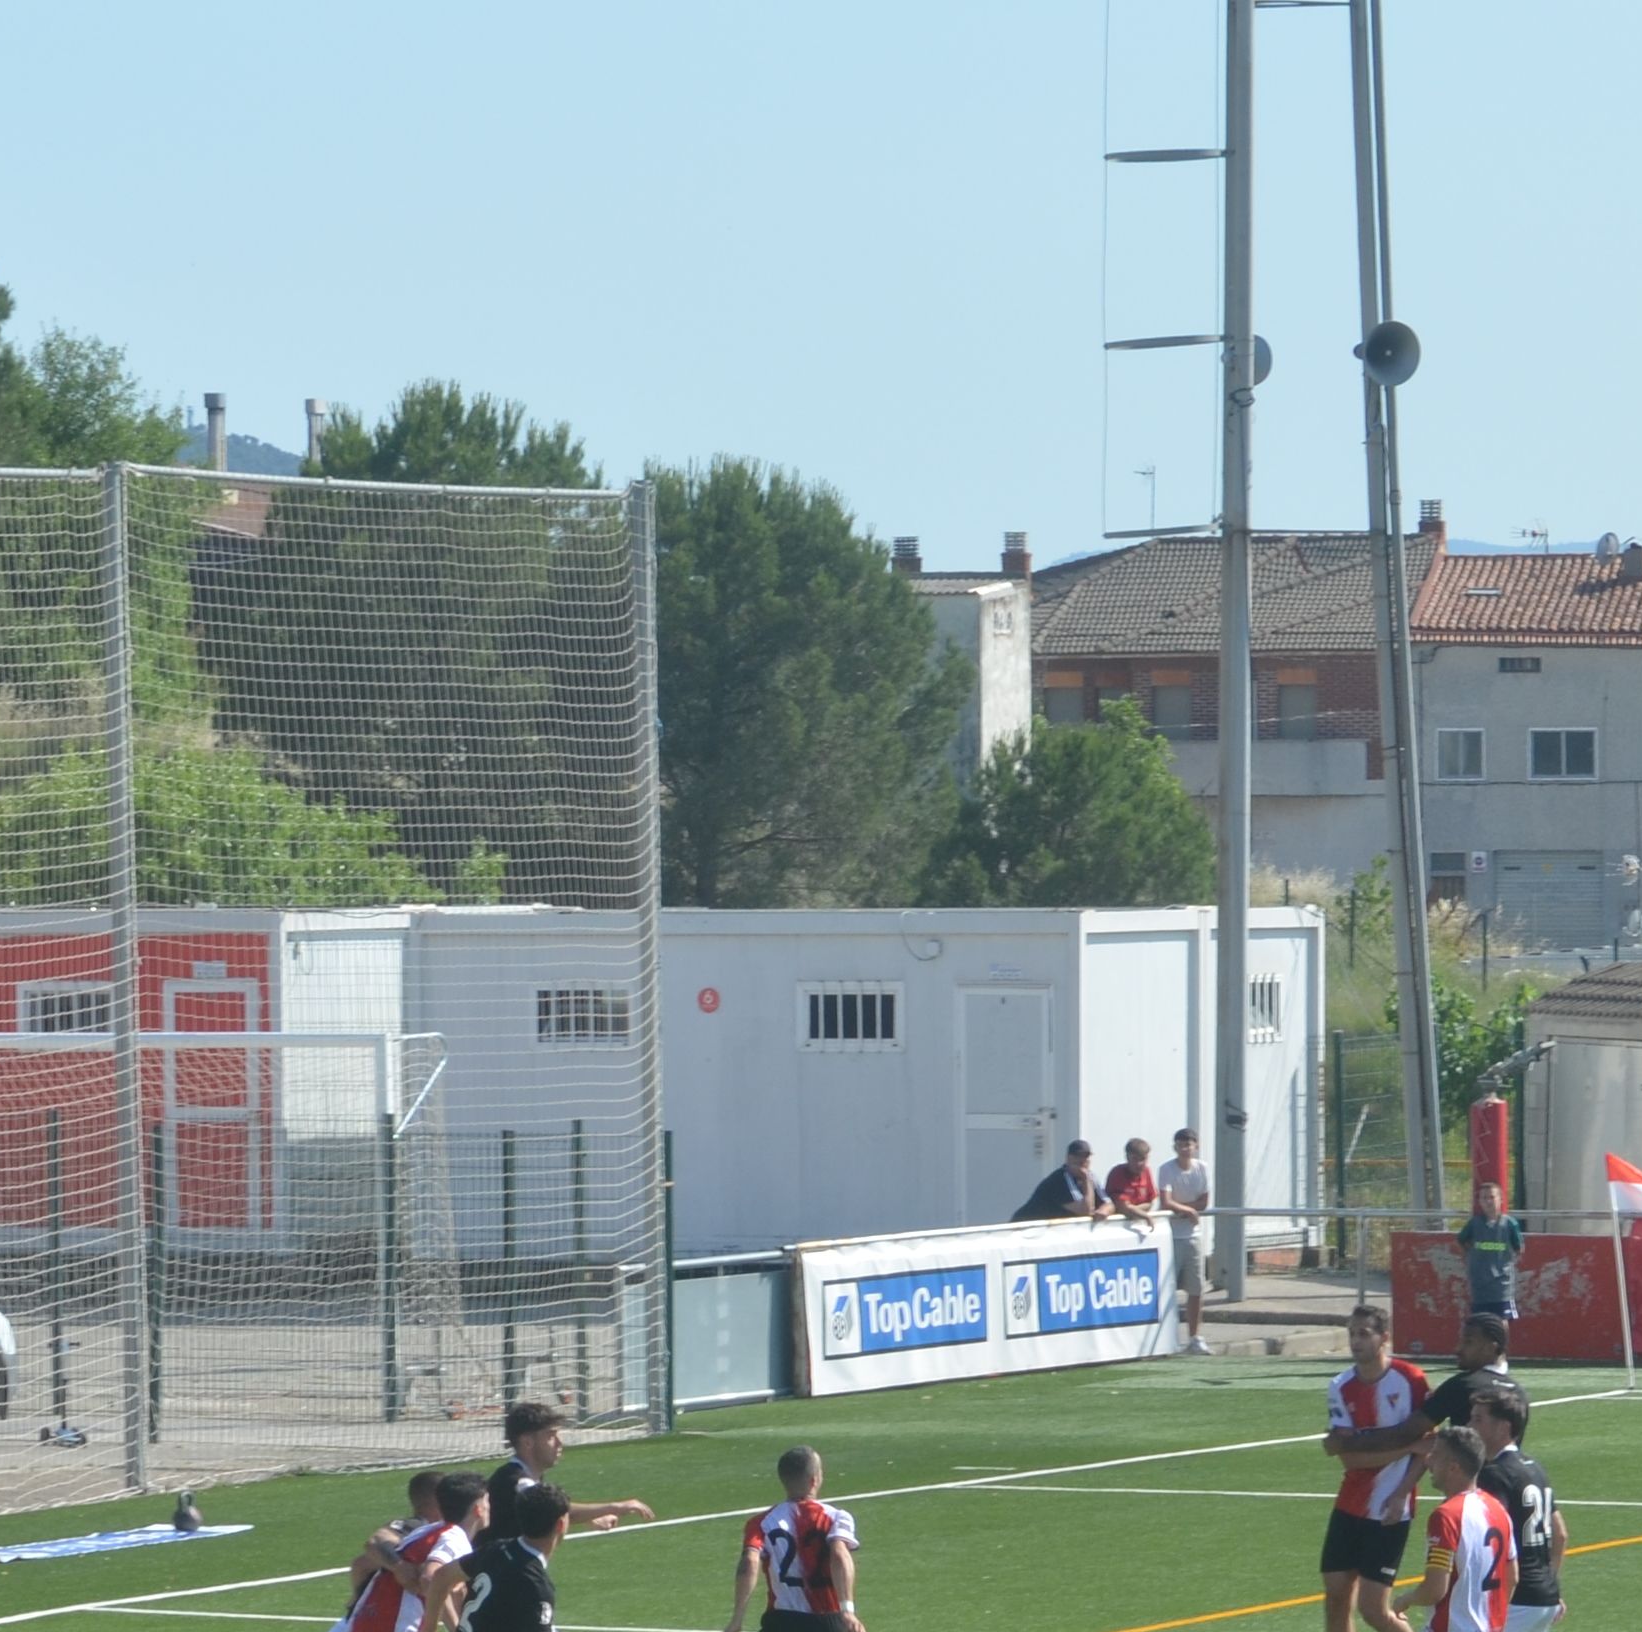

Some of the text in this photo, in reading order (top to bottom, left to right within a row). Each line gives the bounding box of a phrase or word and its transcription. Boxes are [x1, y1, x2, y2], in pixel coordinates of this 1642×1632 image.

[1045, 1267, 1154, 1322] Top Cable
[1481, 1527, 1504, 1592] 2
